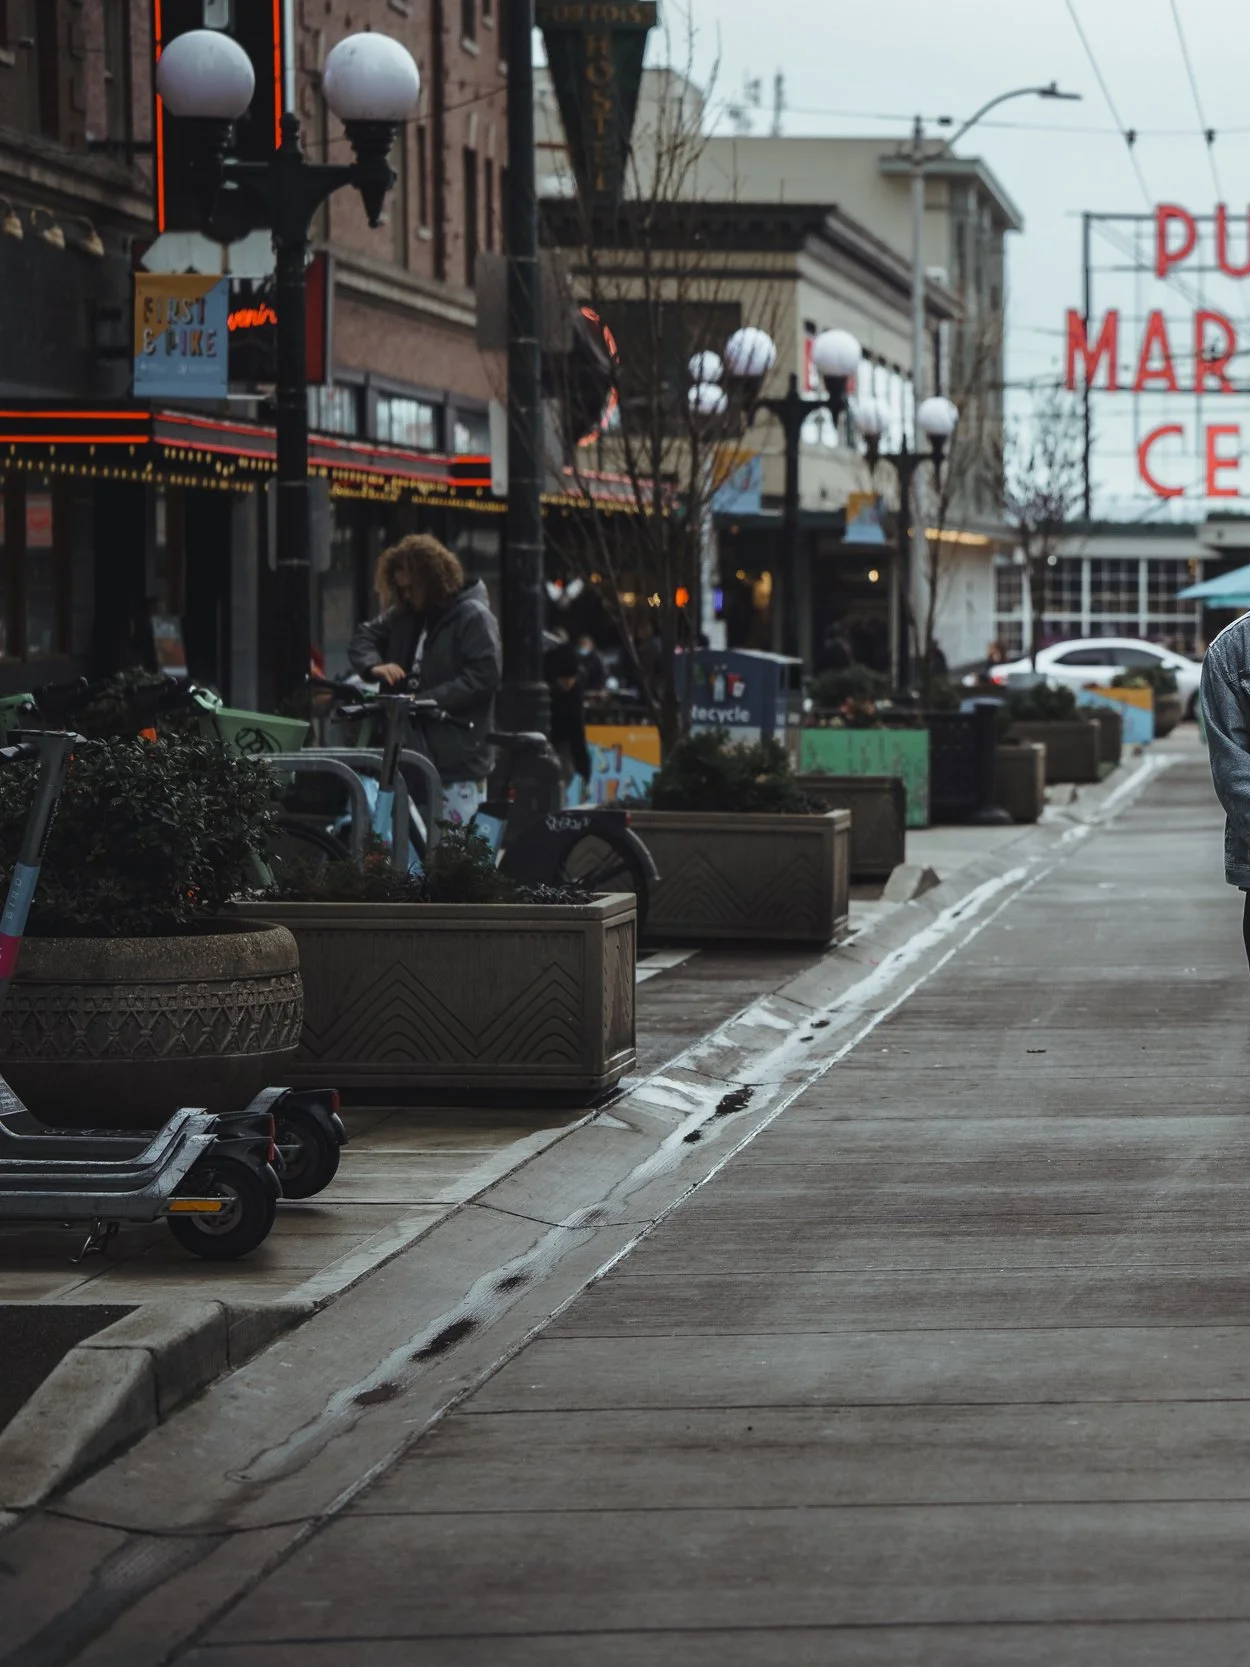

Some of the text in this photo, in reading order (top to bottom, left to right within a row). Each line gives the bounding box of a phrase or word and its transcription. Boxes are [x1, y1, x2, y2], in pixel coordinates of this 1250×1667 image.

[143, 297, 206, 325] FIRST
[165, 329, 217, 357] PIKE
[5, 878, 22, 920] BIRD
